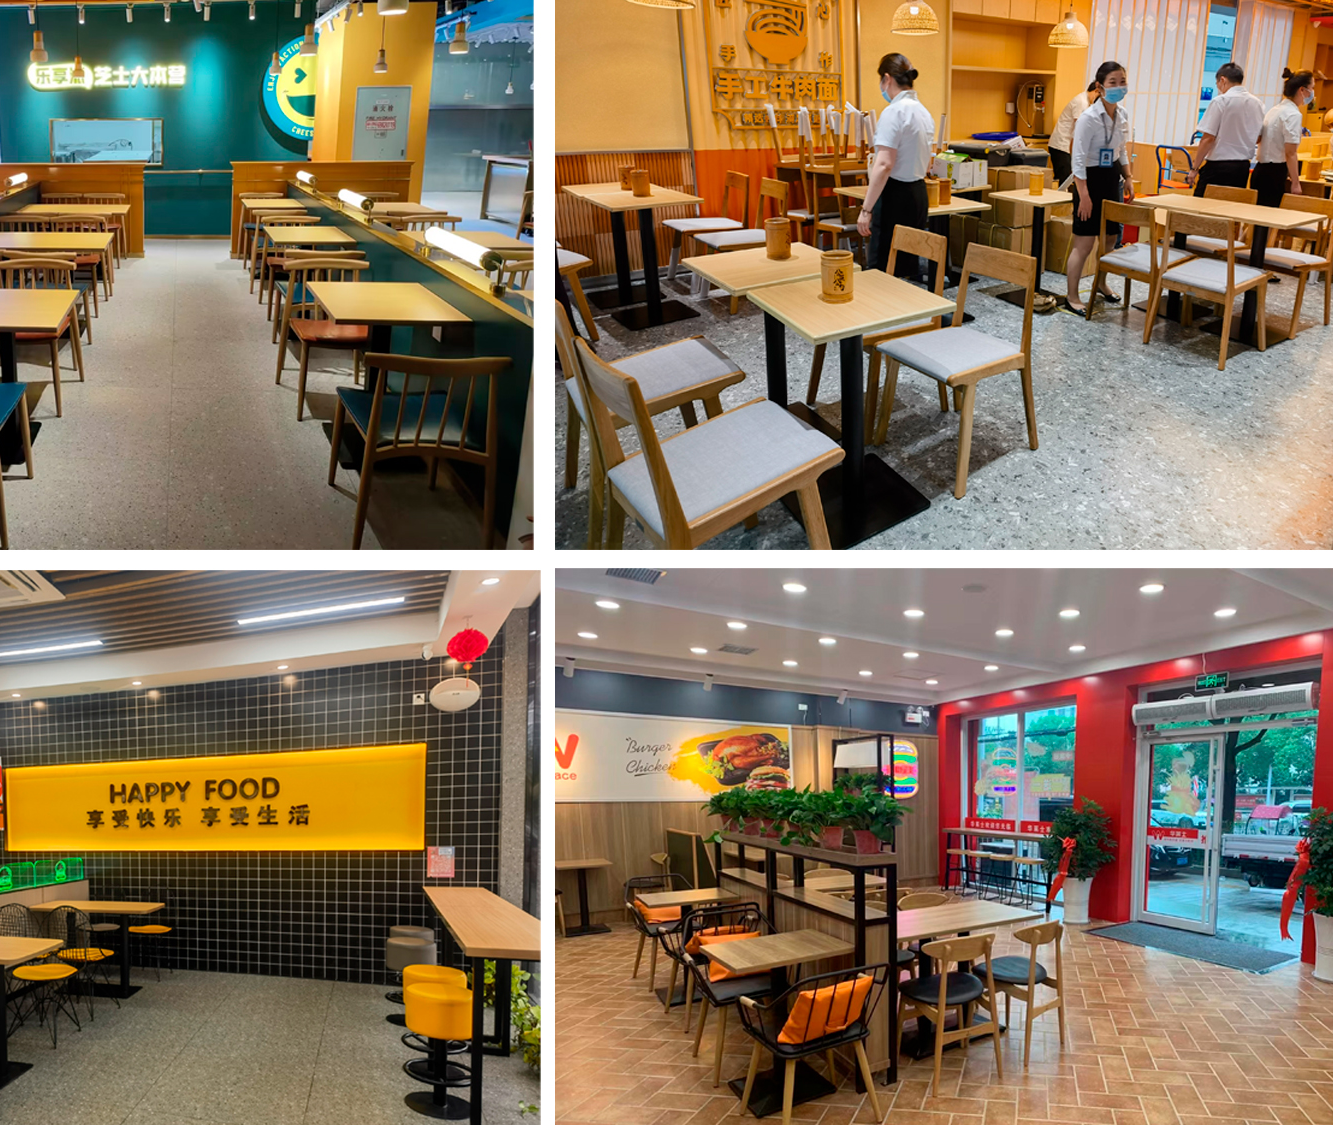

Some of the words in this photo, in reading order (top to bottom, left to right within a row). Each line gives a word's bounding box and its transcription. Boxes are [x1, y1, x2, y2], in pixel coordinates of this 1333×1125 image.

[93, 65, 187, 86] 芝士大本营
[715, 72, 840, 101] 手工牛肉面
[110, 780, 191, 804] HAPPY
[205, 776, 280, 801] FOOD
[86, 808, 182, 829] 享受快乐
[201, 804, 311, 827] 享受生活
